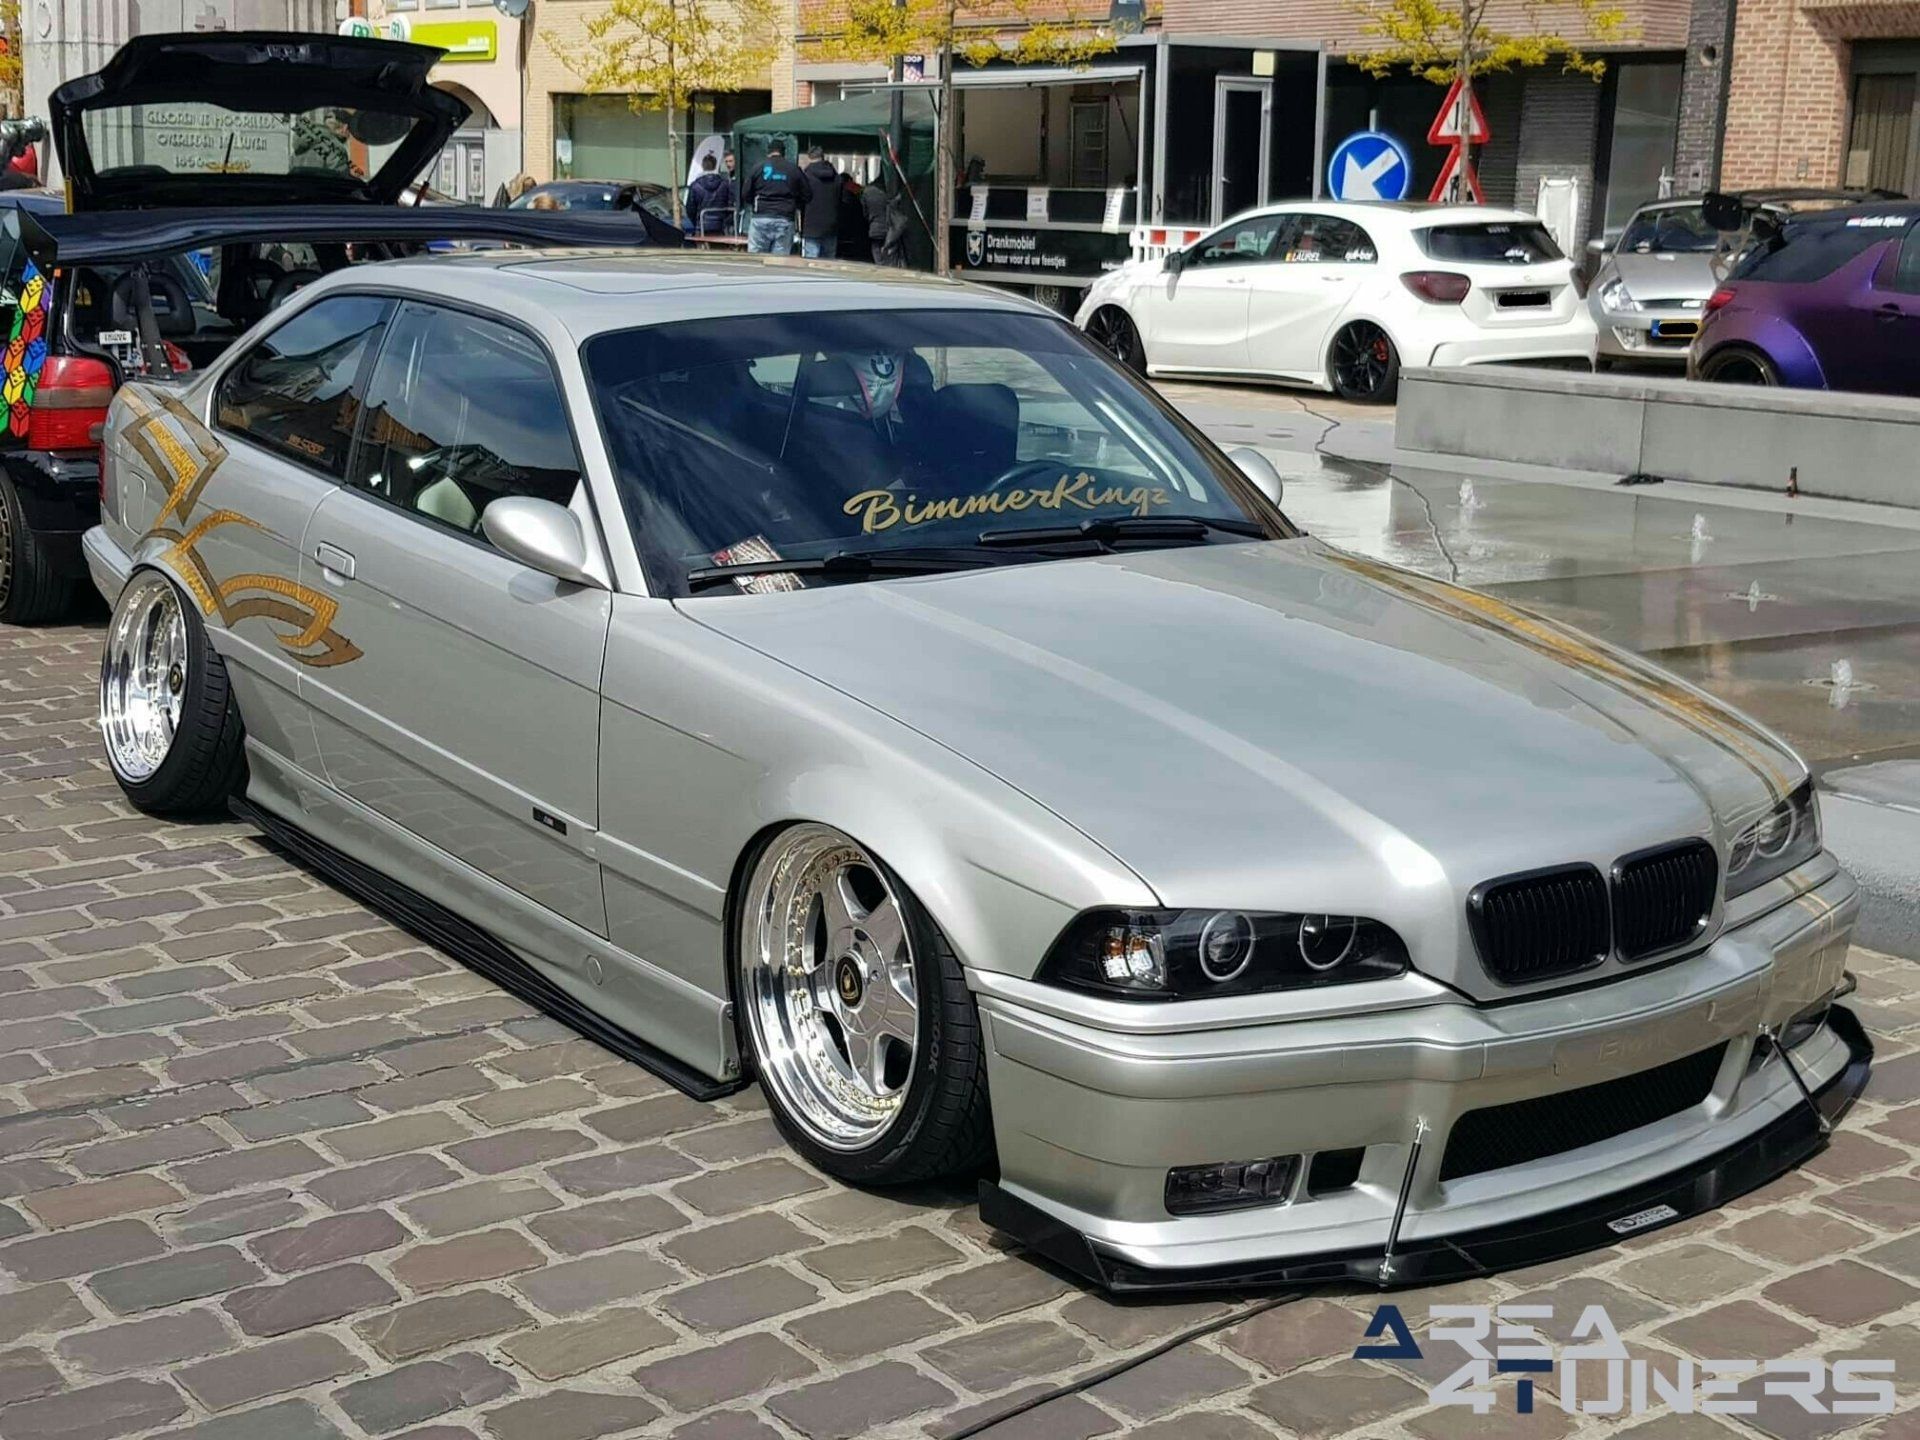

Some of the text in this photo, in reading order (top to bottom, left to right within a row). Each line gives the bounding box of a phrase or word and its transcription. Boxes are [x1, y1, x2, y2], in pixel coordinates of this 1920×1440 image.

[987, 234, 1036, 250] Drankmobiel
[987, 253, 993, 262] te
[1010, 255, 1024, 265] voor
[1042, 255, 1066, 269] feestjes
[843, 471, 1172, 536] BimmerKingz
